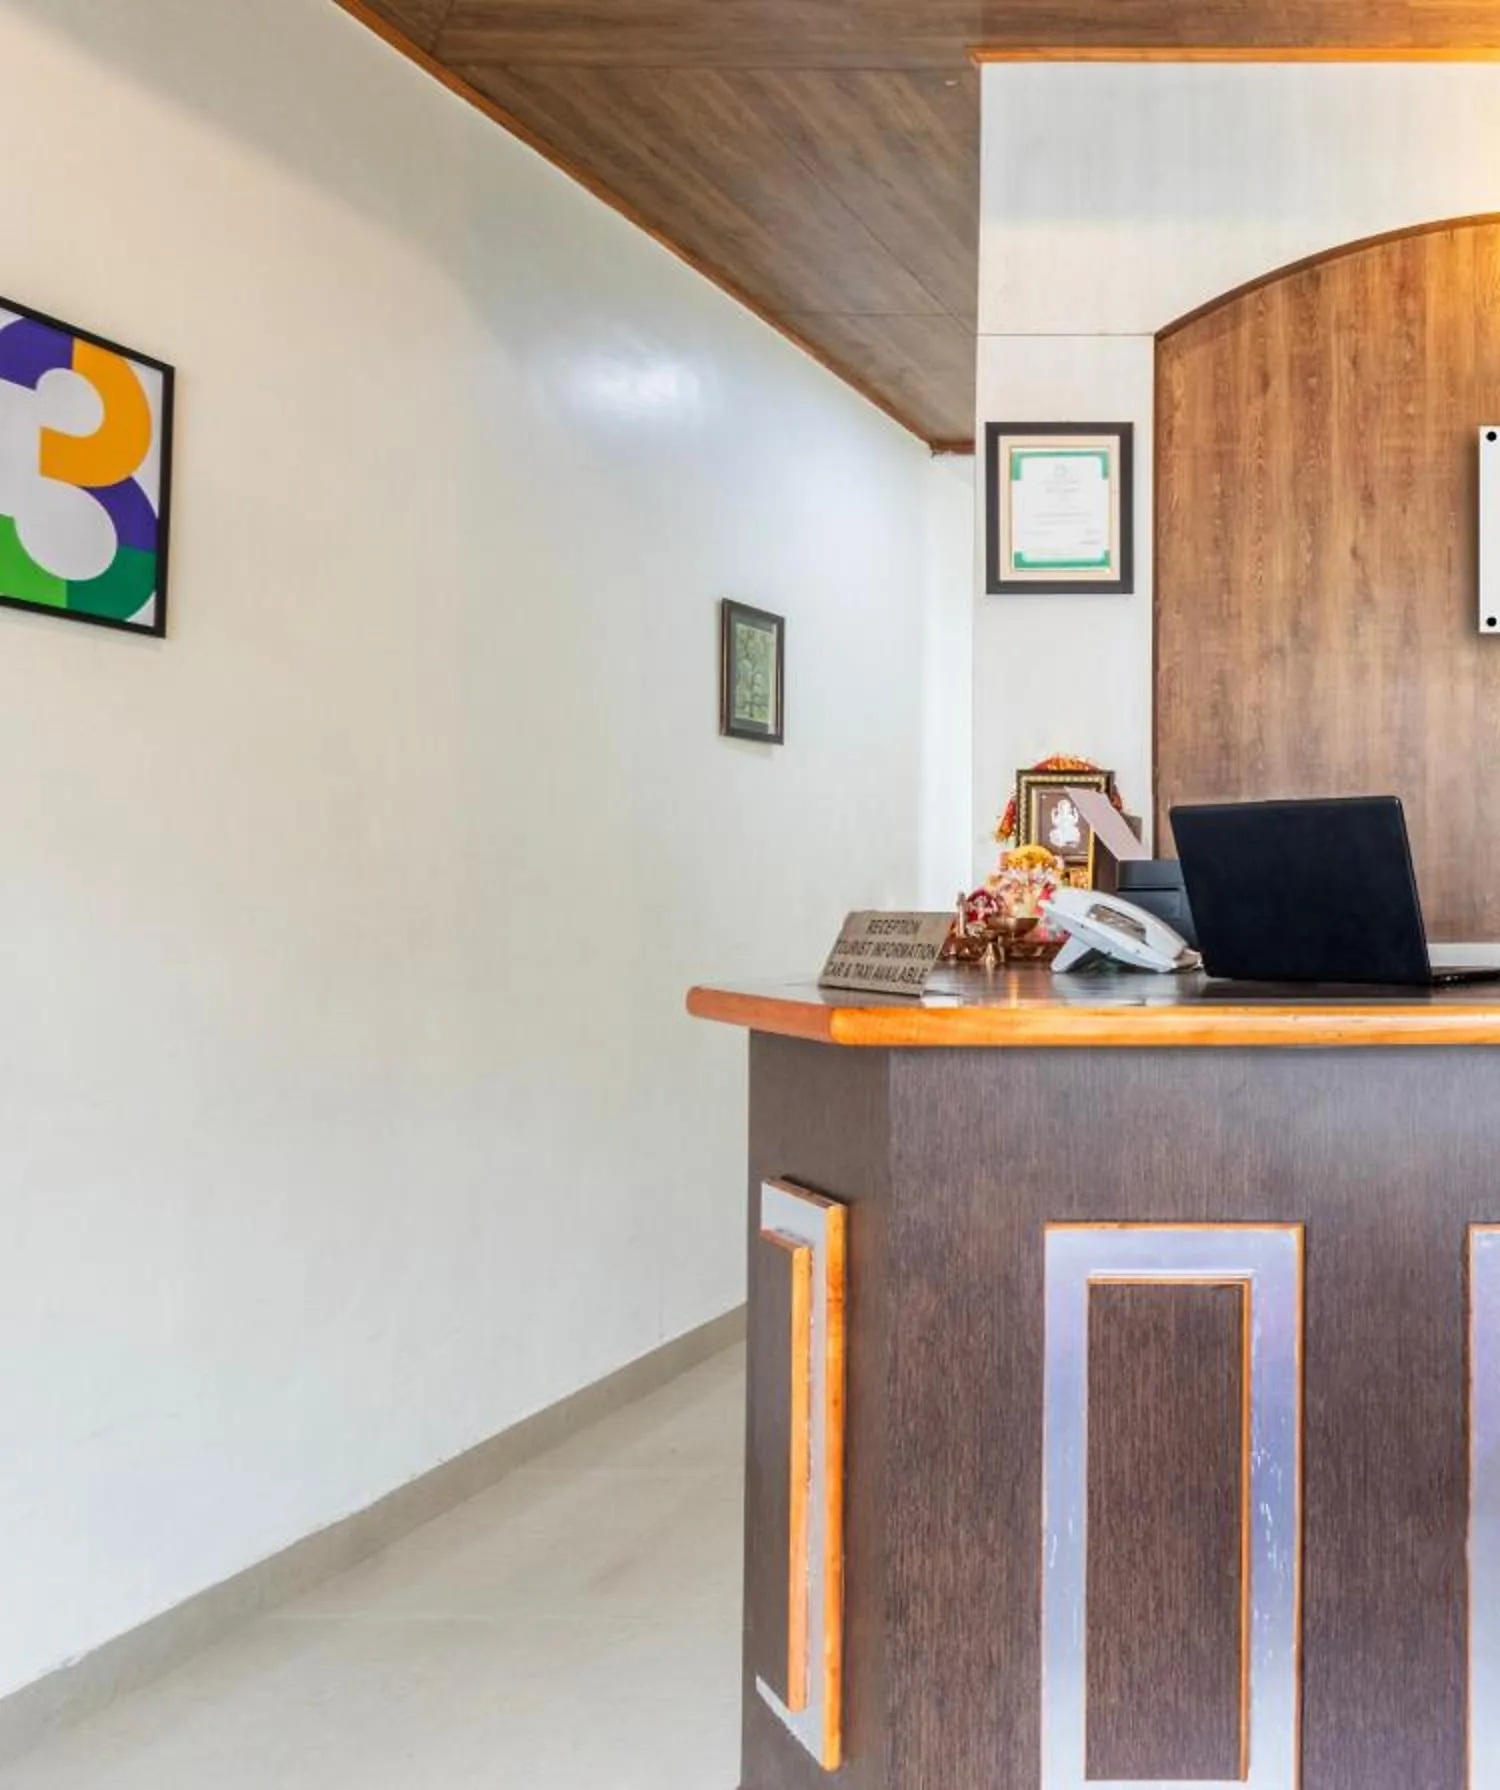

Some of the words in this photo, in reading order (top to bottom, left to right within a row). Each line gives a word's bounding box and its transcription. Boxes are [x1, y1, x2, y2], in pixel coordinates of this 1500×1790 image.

[866, 919, 922, 935] RECEPTION
[833, 940, 873, 956] TOURIST
[872, 942, 939, 961] INFORMATION
[823, 961, 845, 977] CAR
[852, 962, 874, 981] TAXI
[871, 965, 930, 985] AVAILABLE
